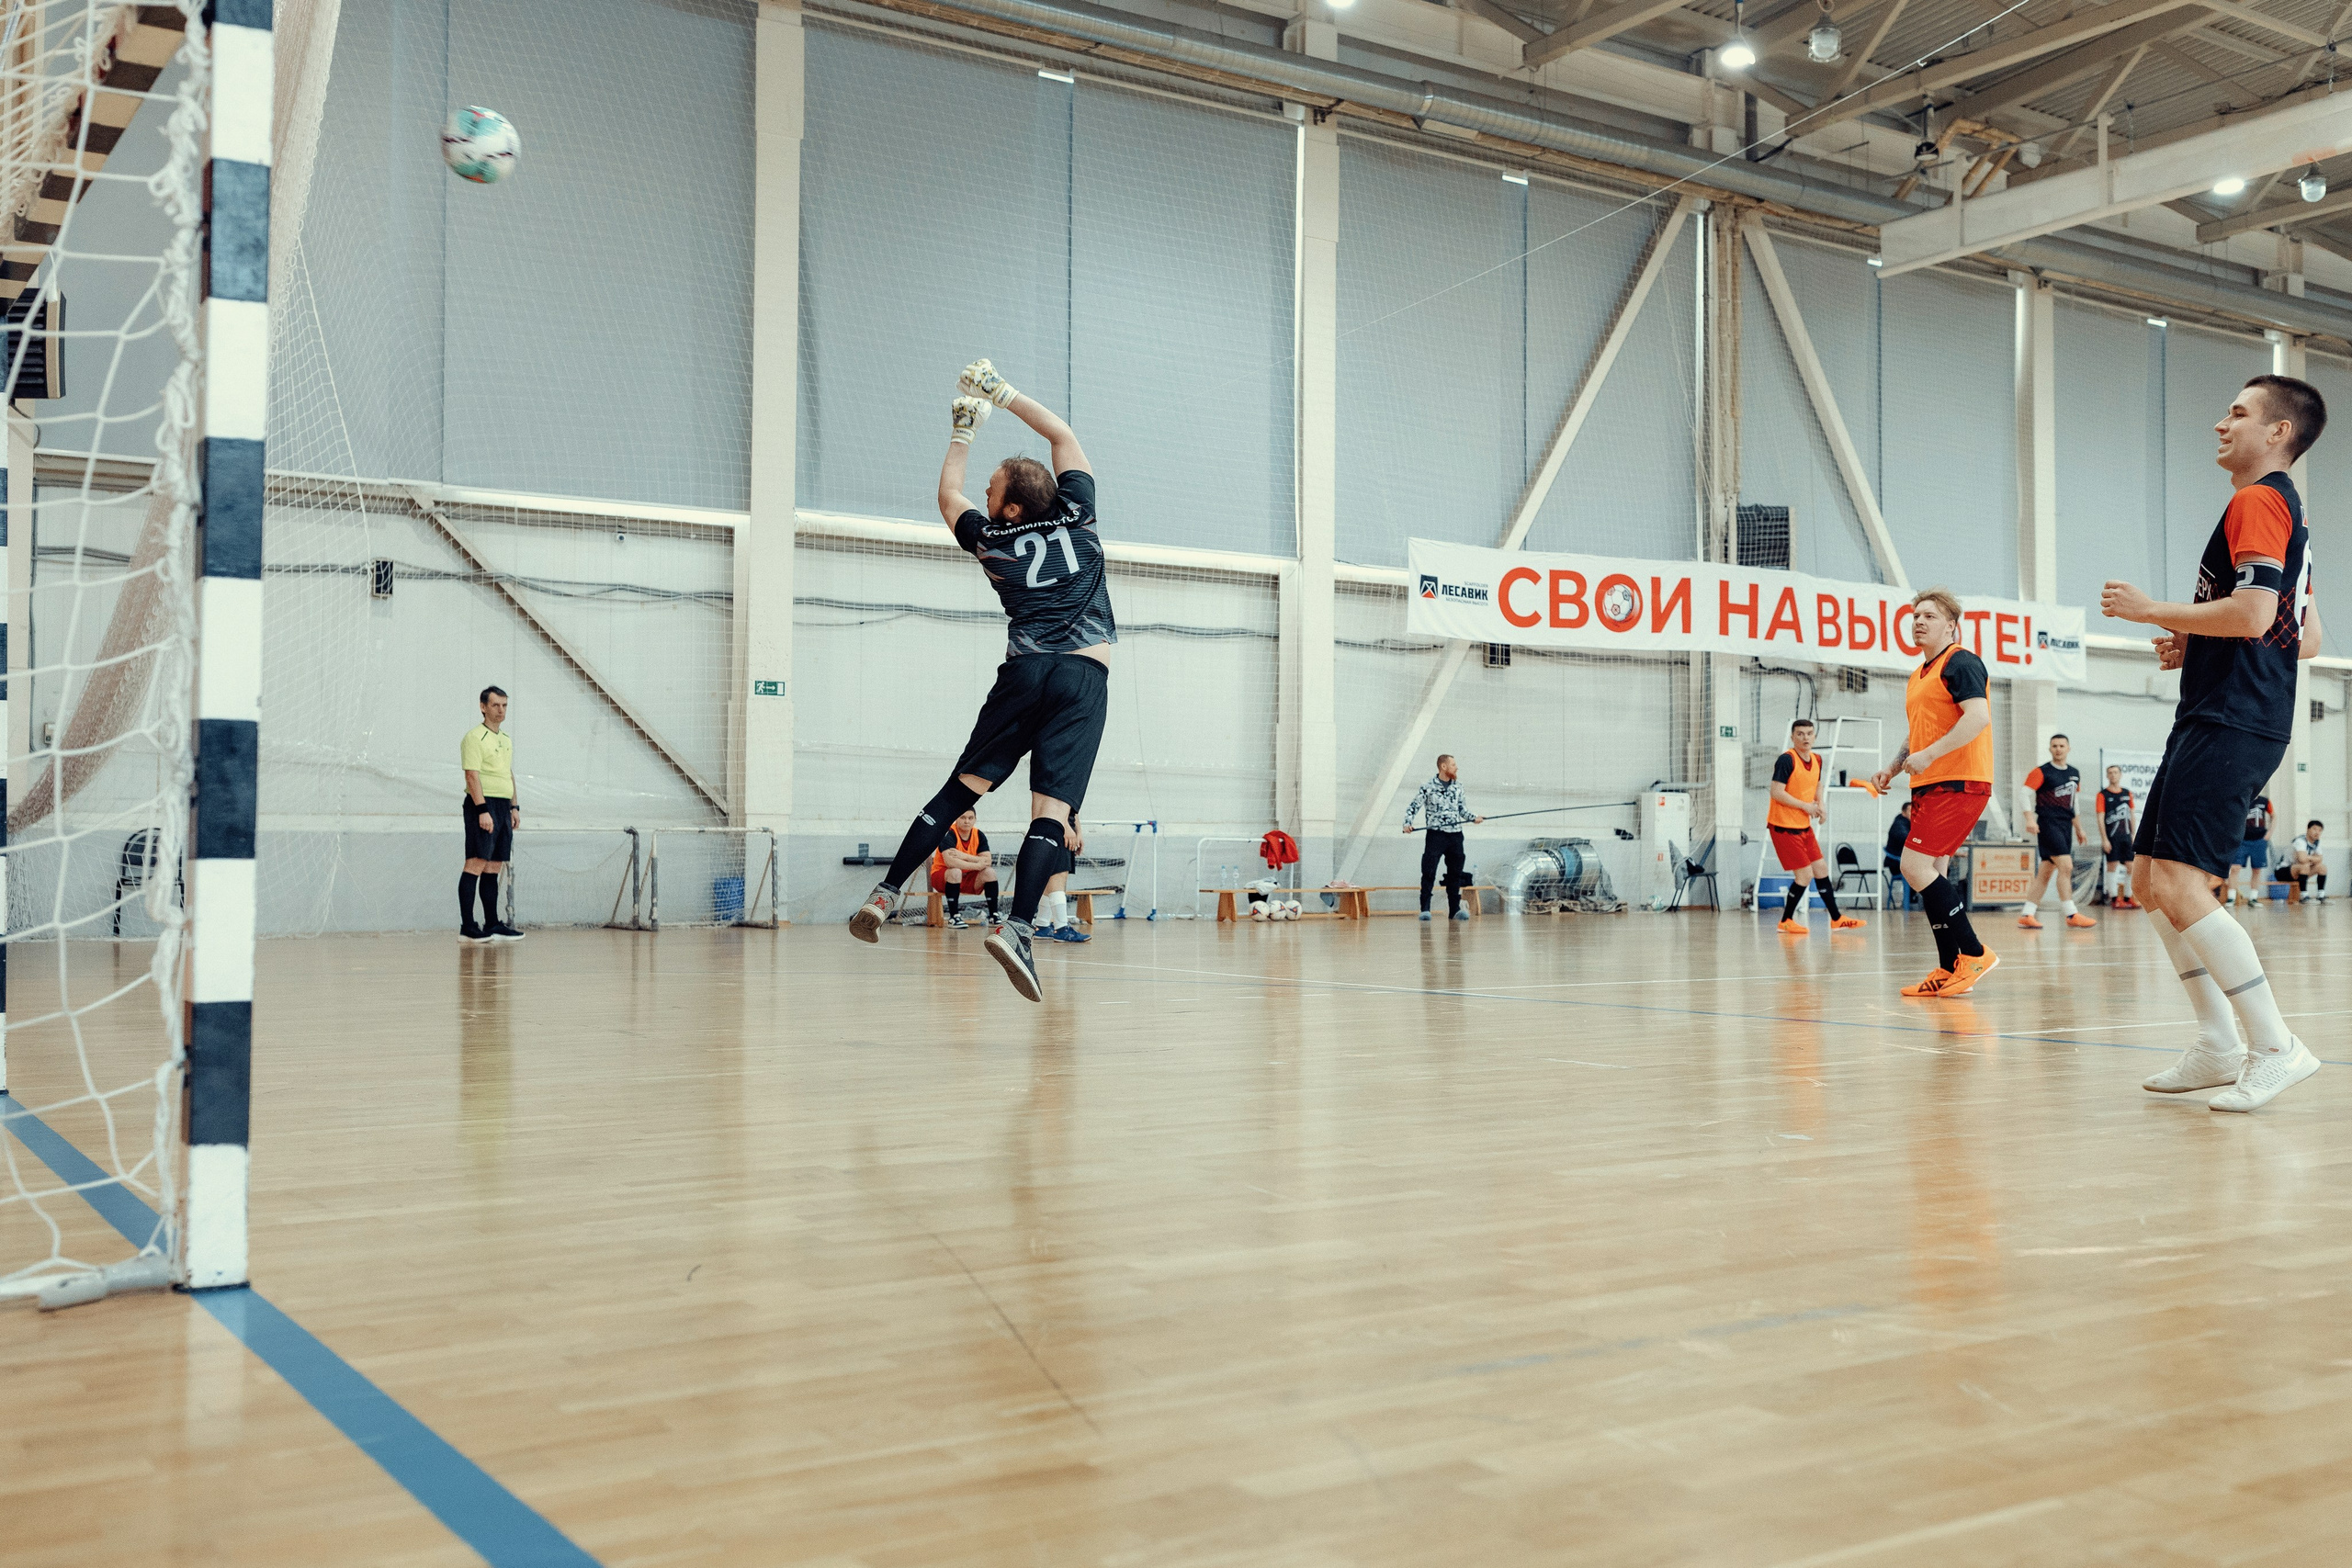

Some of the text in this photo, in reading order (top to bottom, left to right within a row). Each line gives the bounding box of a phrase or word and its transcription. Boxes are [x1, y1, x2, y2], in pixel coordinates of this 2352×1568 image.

[1014, 526, 1080, 588] 21
[1442, 583, 1488, 601] ЛЕСАВИК
[1498, 566, 2032, 665] СВОИ НА ВЫСТЕ!
[1989, 879, 2029, 893] FIRST
